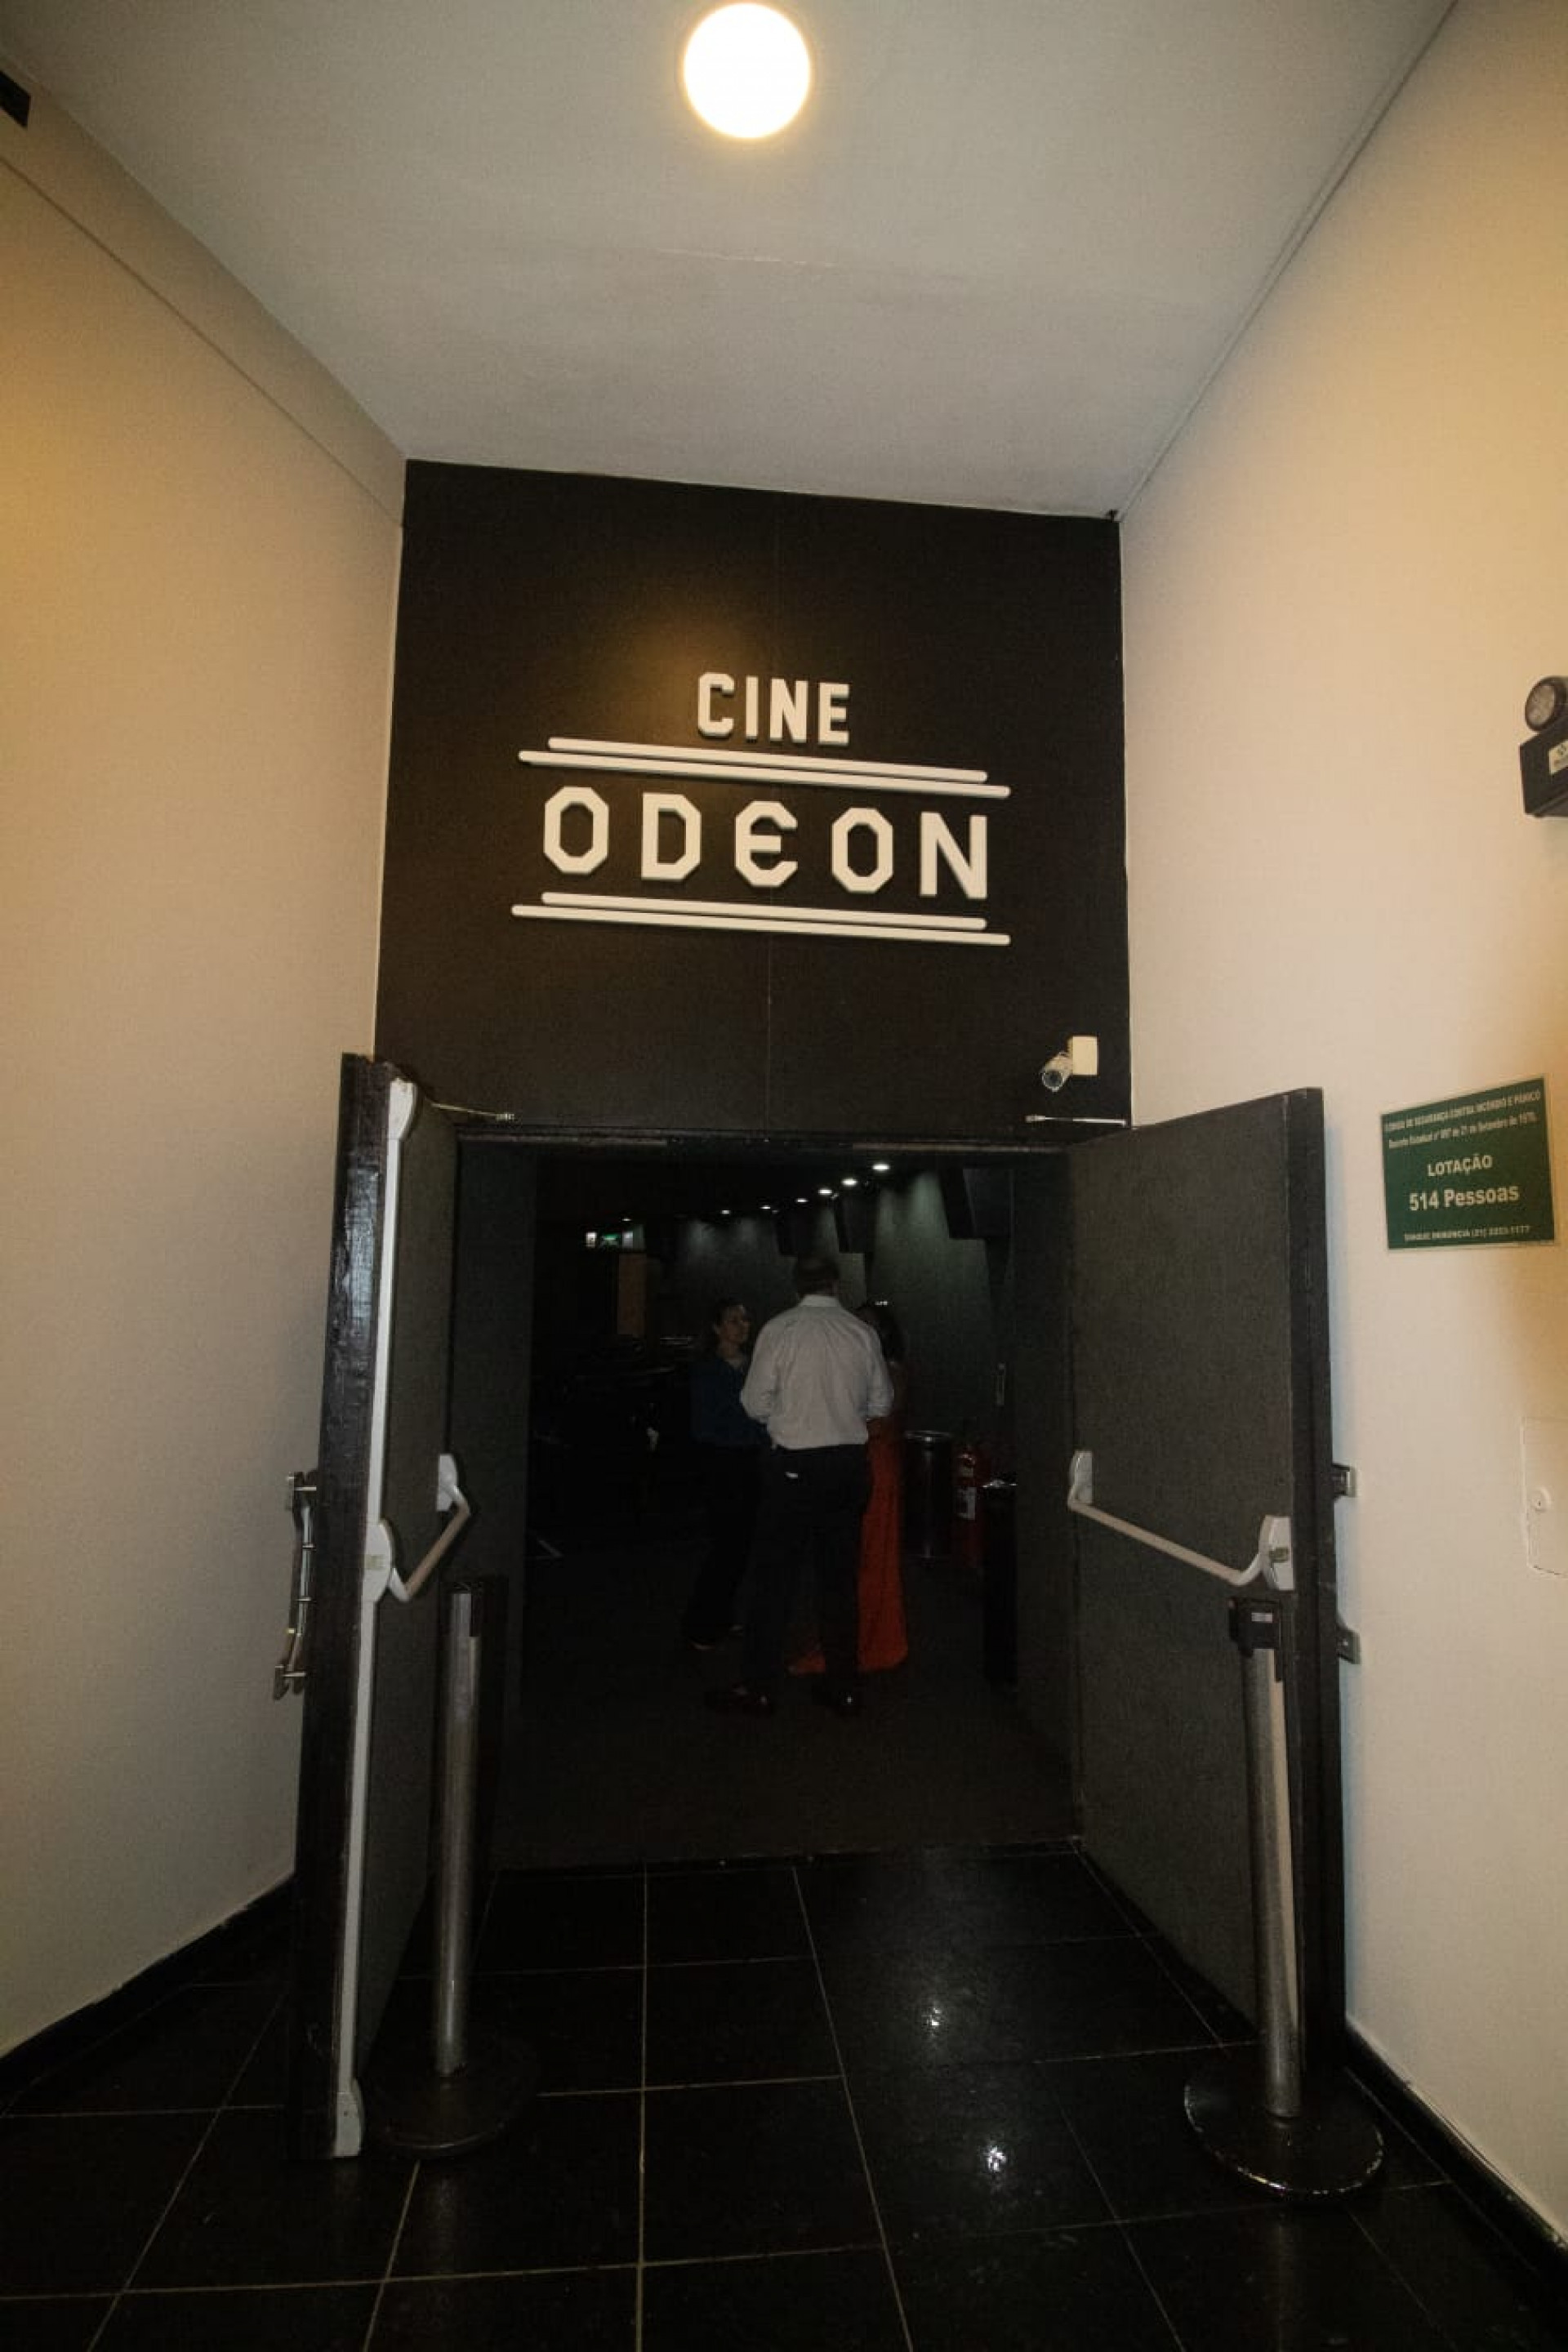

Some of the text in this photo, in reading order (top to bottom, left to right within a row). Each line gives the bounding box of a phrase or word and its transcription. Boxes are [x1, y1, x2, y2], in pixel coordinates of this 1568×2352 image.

[697, 671, 850, 746] CINE
[542, 786, 988, 900] ODEON
[1428, 1152, 1493, 1177] LOTAÇÃO
[1409, 1185, 1520, 1211] 514 Pessoas
